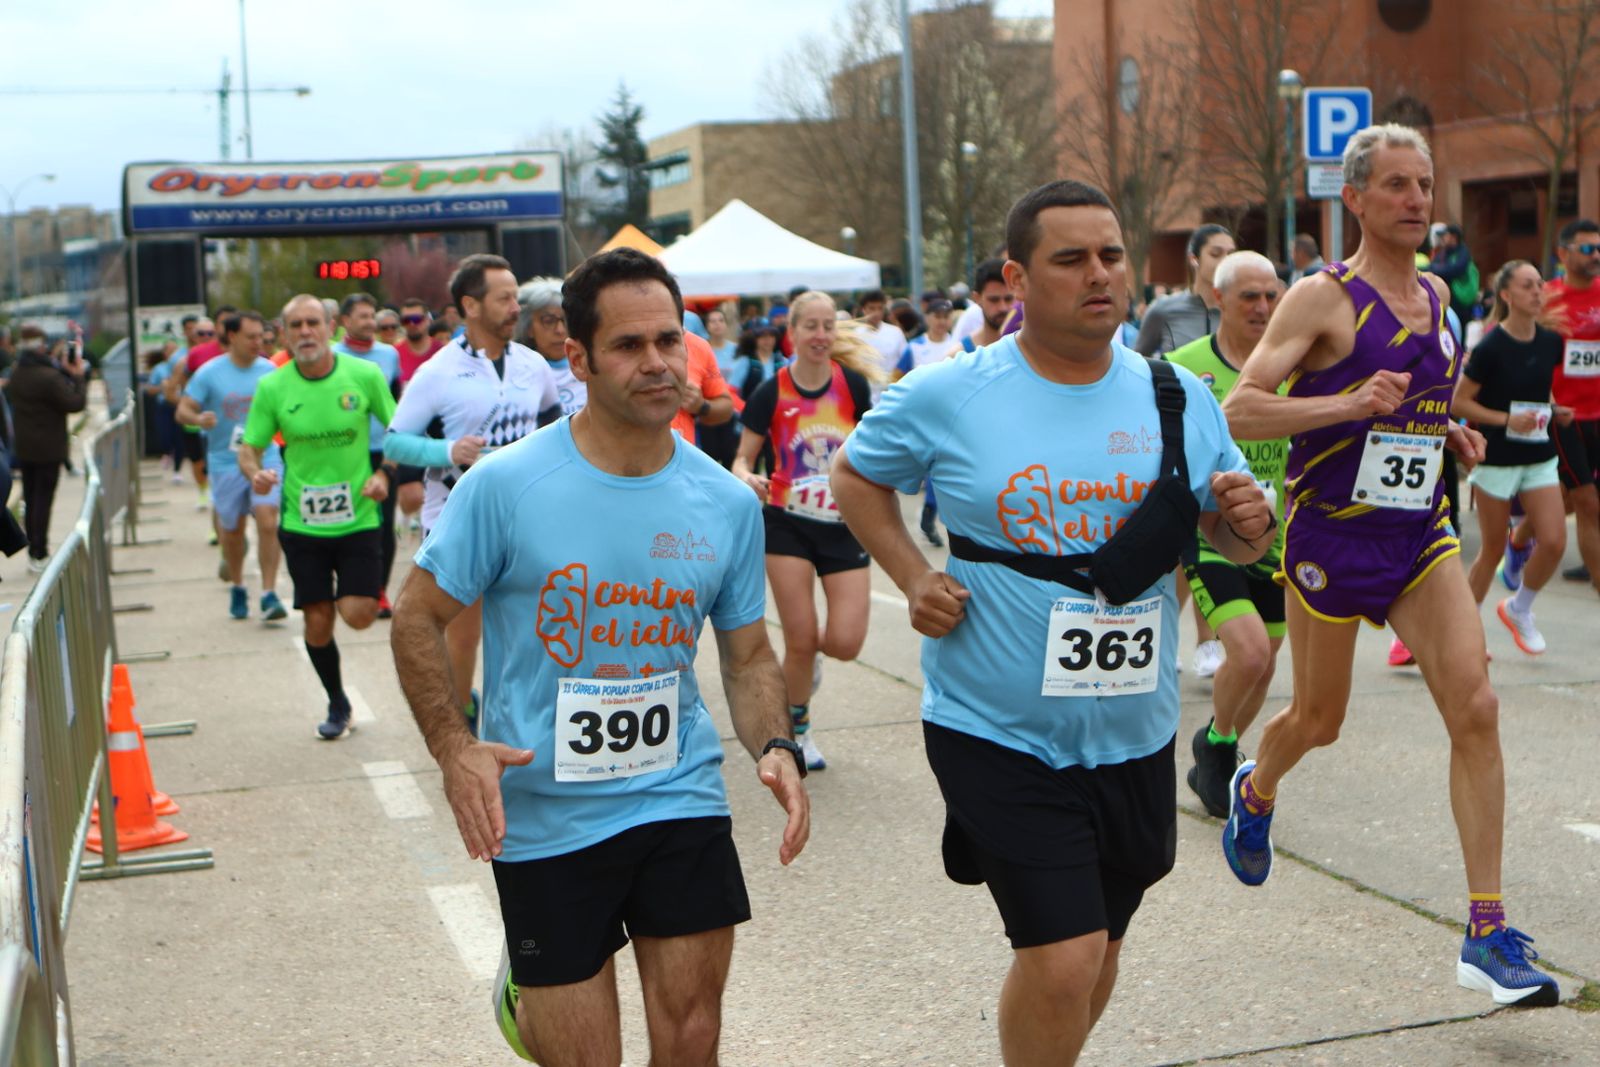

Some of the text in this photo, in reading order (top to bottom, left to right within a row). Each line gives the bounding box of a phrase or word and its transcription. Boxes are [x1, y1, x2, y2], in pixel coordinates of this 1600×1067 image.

[1319, 97, 1359, 153] P
[148, 161, 544, 197] OrycronSport
[190, 199, 509, 221] www.orycronsport.com
[1380, 455, 1427, 490] 35
[305, 494, 348, 514] 122
[798, 487, 838, 511] 11
[1064, 514, 1097, 542] el
[594, 578, 696, 610] contra
[591, 618, 624, 647] el
[1058, 627, 1154, 671] 363
[563, 683, 571, 693] II
[572, 681, 601, 696] CARRERA
[602, 684, 630, 697] POPULAR
[631, 681, 654, 695] CONTRA
[568, 704, 670, 754] 390
